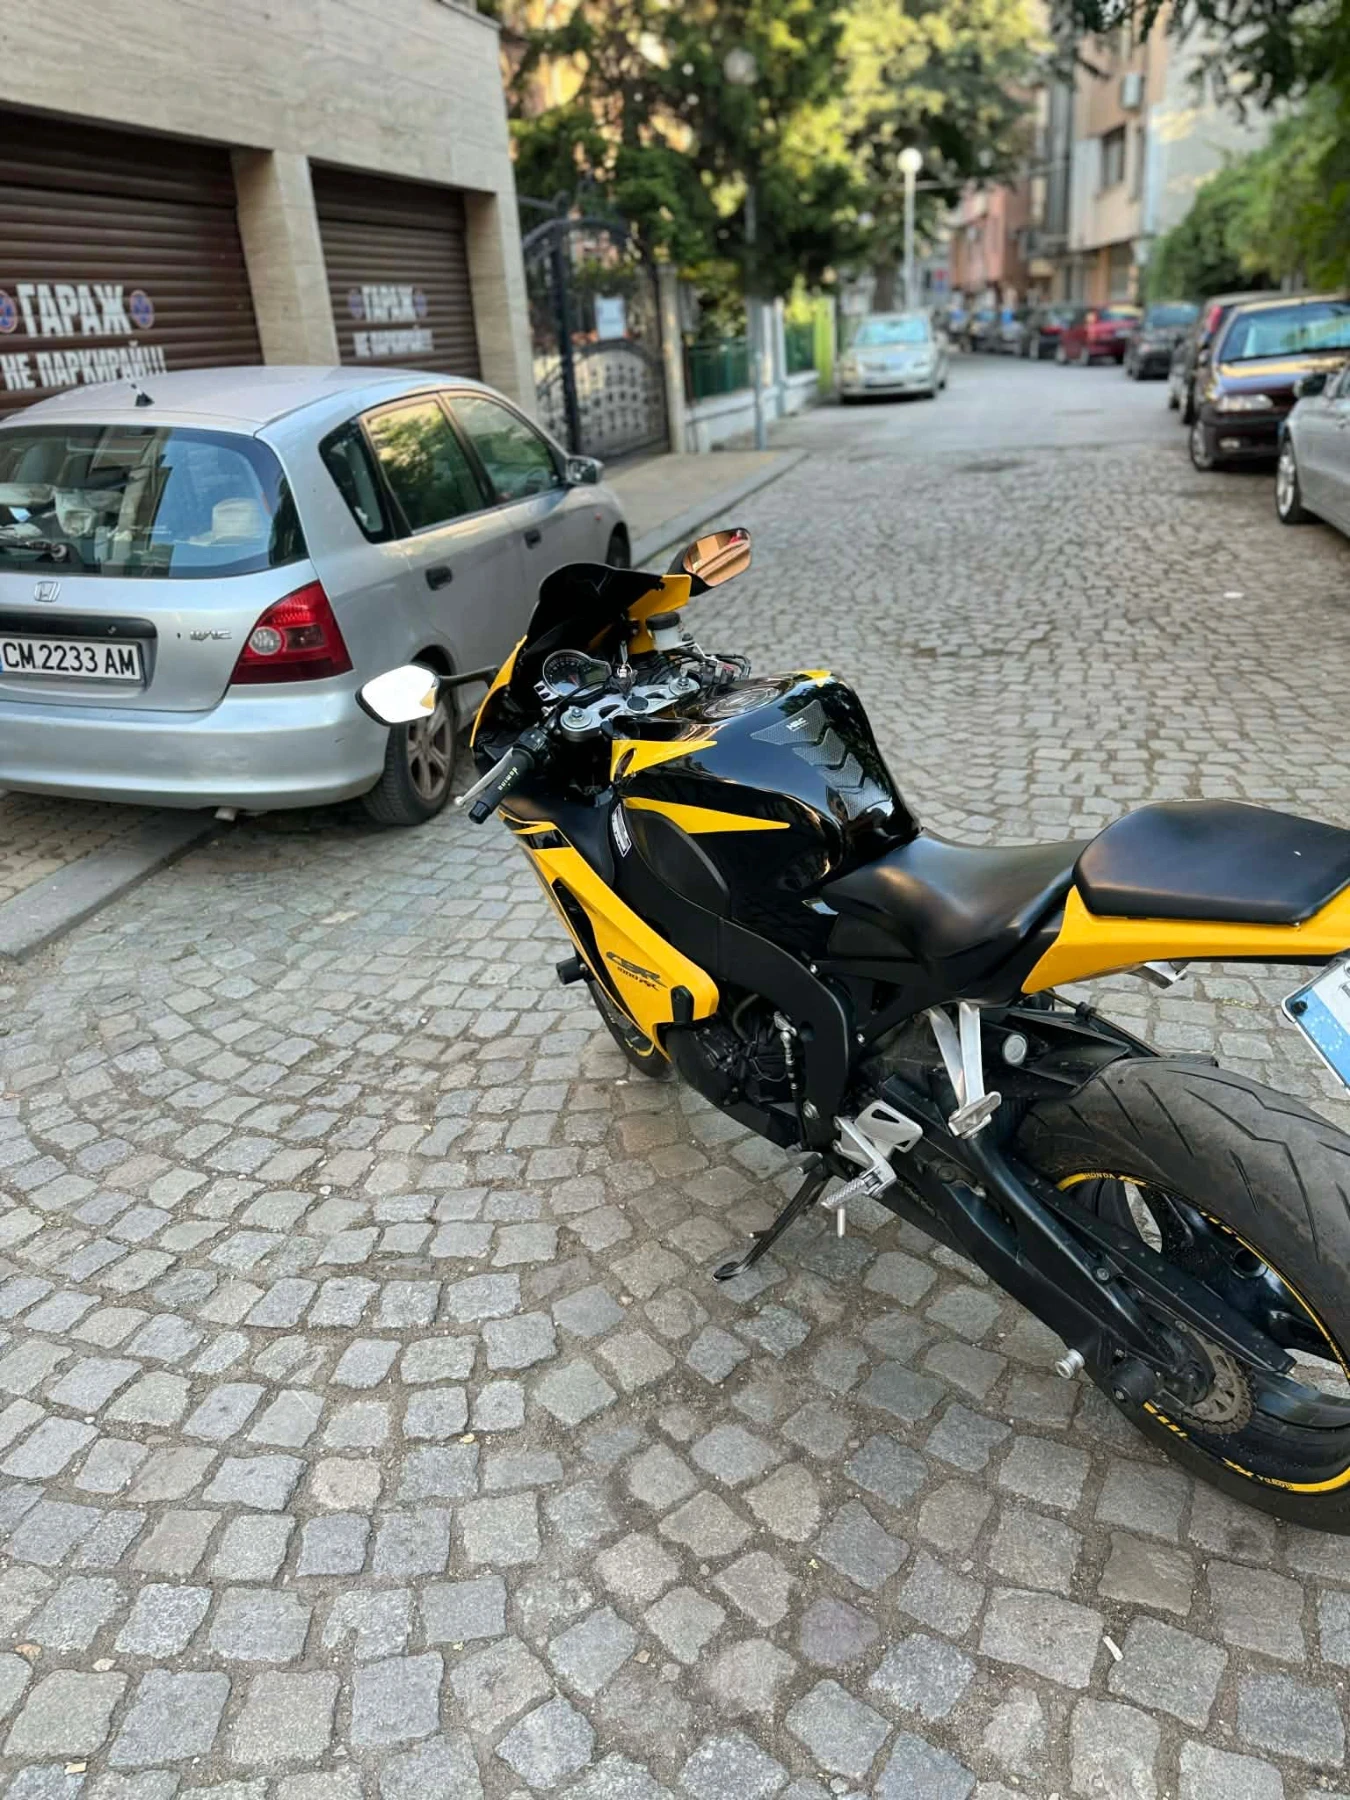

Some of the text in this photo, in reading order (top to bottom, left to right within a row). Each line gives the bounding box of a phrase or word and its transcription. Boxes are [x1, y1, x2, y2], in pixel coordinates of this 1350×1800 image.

[16, 284, 132, 338] ГАРАЖ
[1, 353, 36, 391] НЕ
[39, 643, 98, 673] 2233
[104, 647, 136, 676] AM
